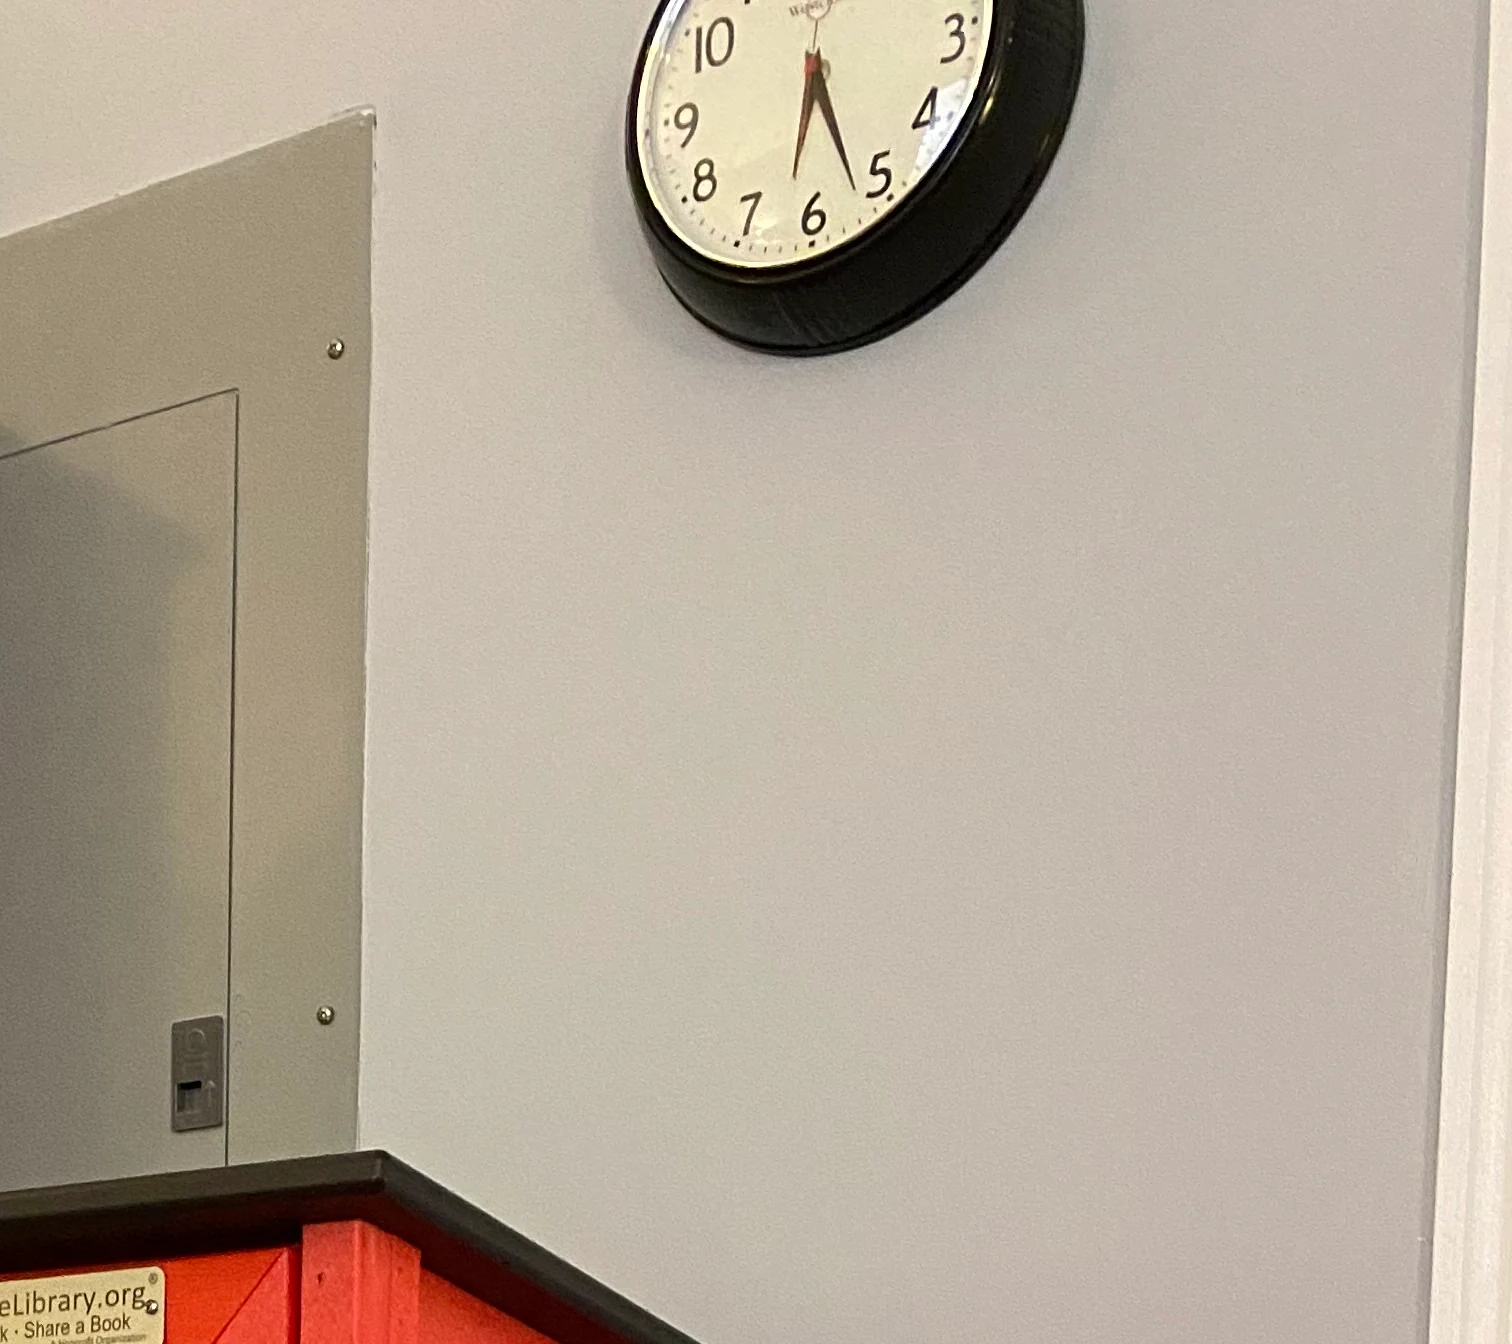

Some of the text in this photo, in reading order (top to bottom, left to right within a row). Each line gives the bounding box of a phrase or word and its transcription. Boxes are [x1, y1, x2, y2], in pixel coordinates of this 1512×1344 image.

[694, 17, 735, 72] 10
[940, 13, 966, 64] 3
[674, 102, 699, 148] 9
[912, 86, 940, 130] 4
[692, 158, 717, 201] 8
[866, 151, 892, 198] 5
[740, 192, 762, 235] 7
[801, 192, 826, 234] 6
[25, 1314, 70, 1338] Share
[76, 1320, 85, 1334] a
[90, 1312, 131, 1333] Book
